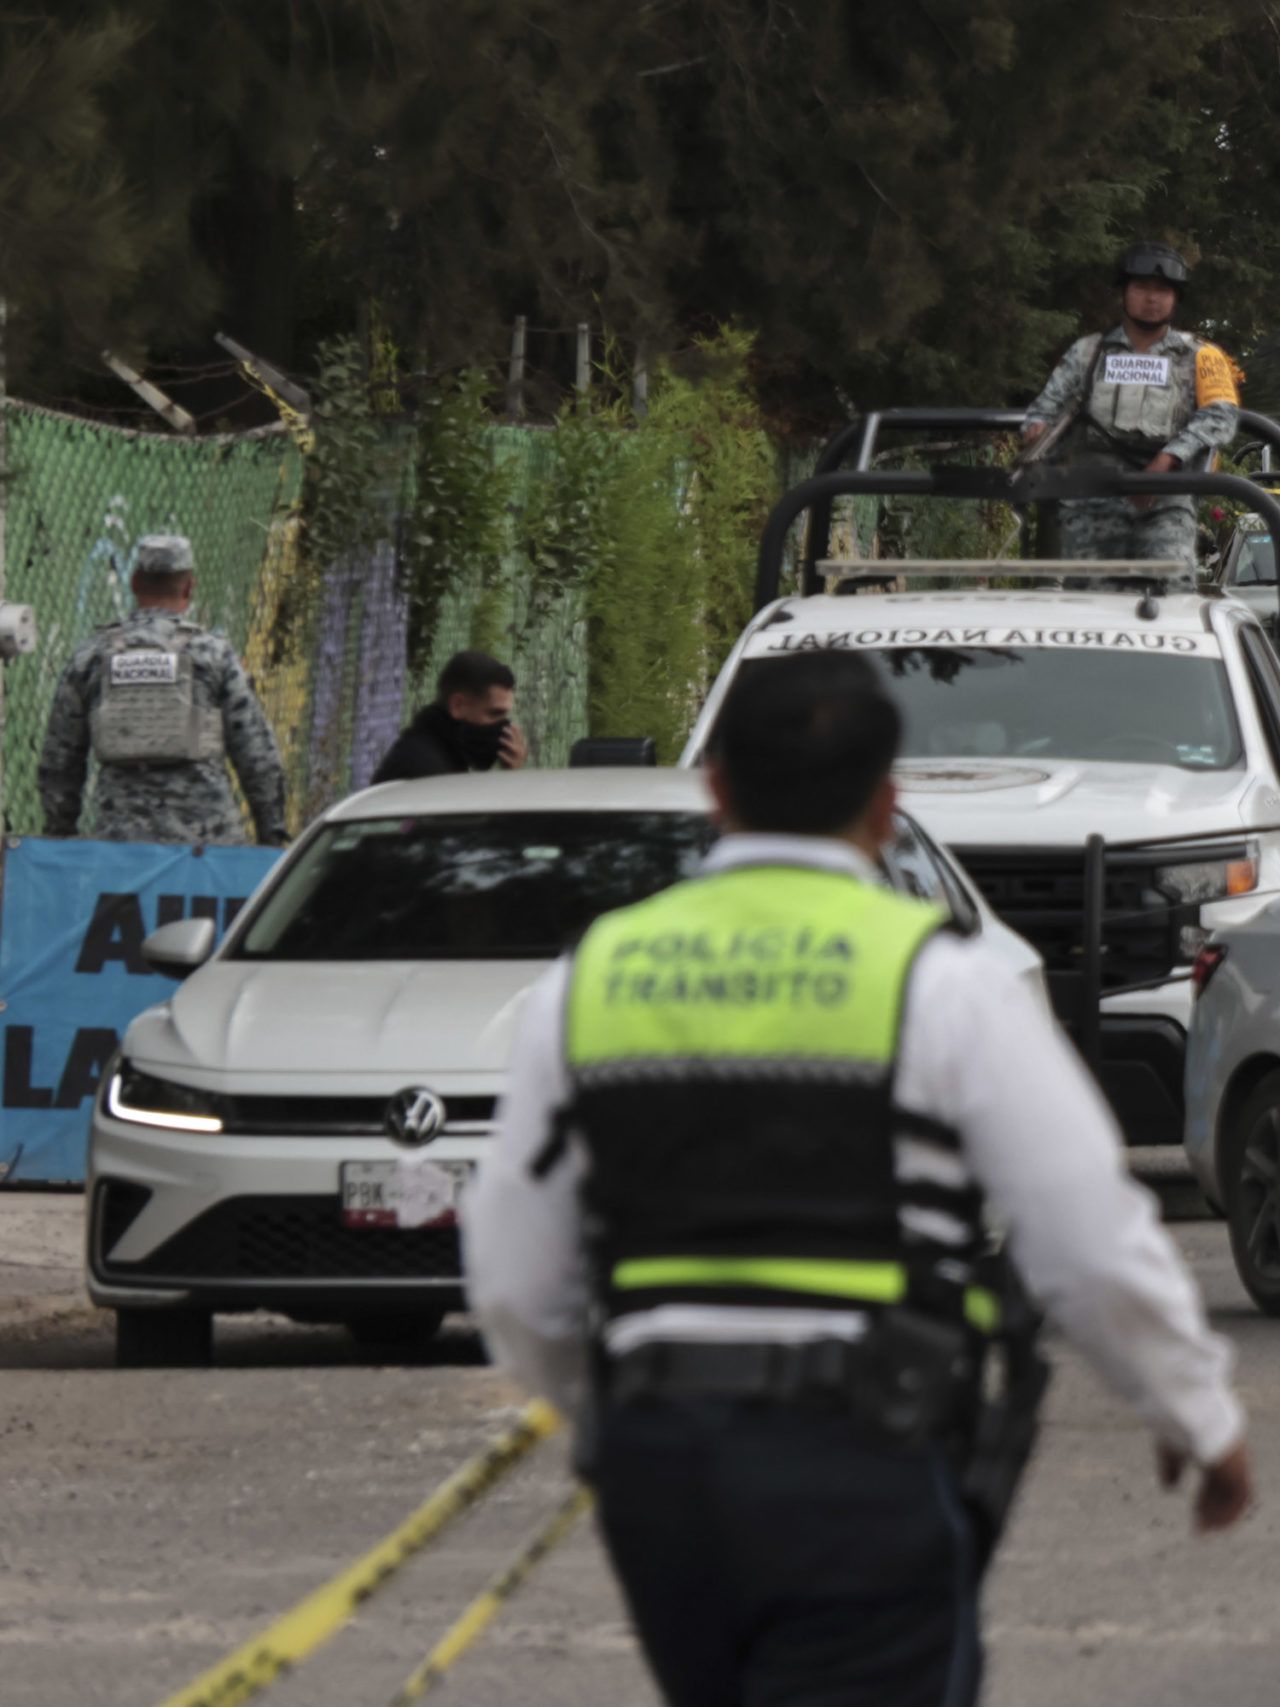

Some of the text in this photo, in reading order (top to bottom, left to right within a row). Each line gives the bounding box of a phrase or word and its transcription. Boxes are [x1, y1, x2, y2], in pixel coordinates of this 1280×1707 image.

[1110, 358, 1163, 370] GUARDIA
[1106, 370, 1164, 383] NACIONAL
[116, 655, 171, 667] GUARDIA
[113, 668, 173, 680] NACIONAL
